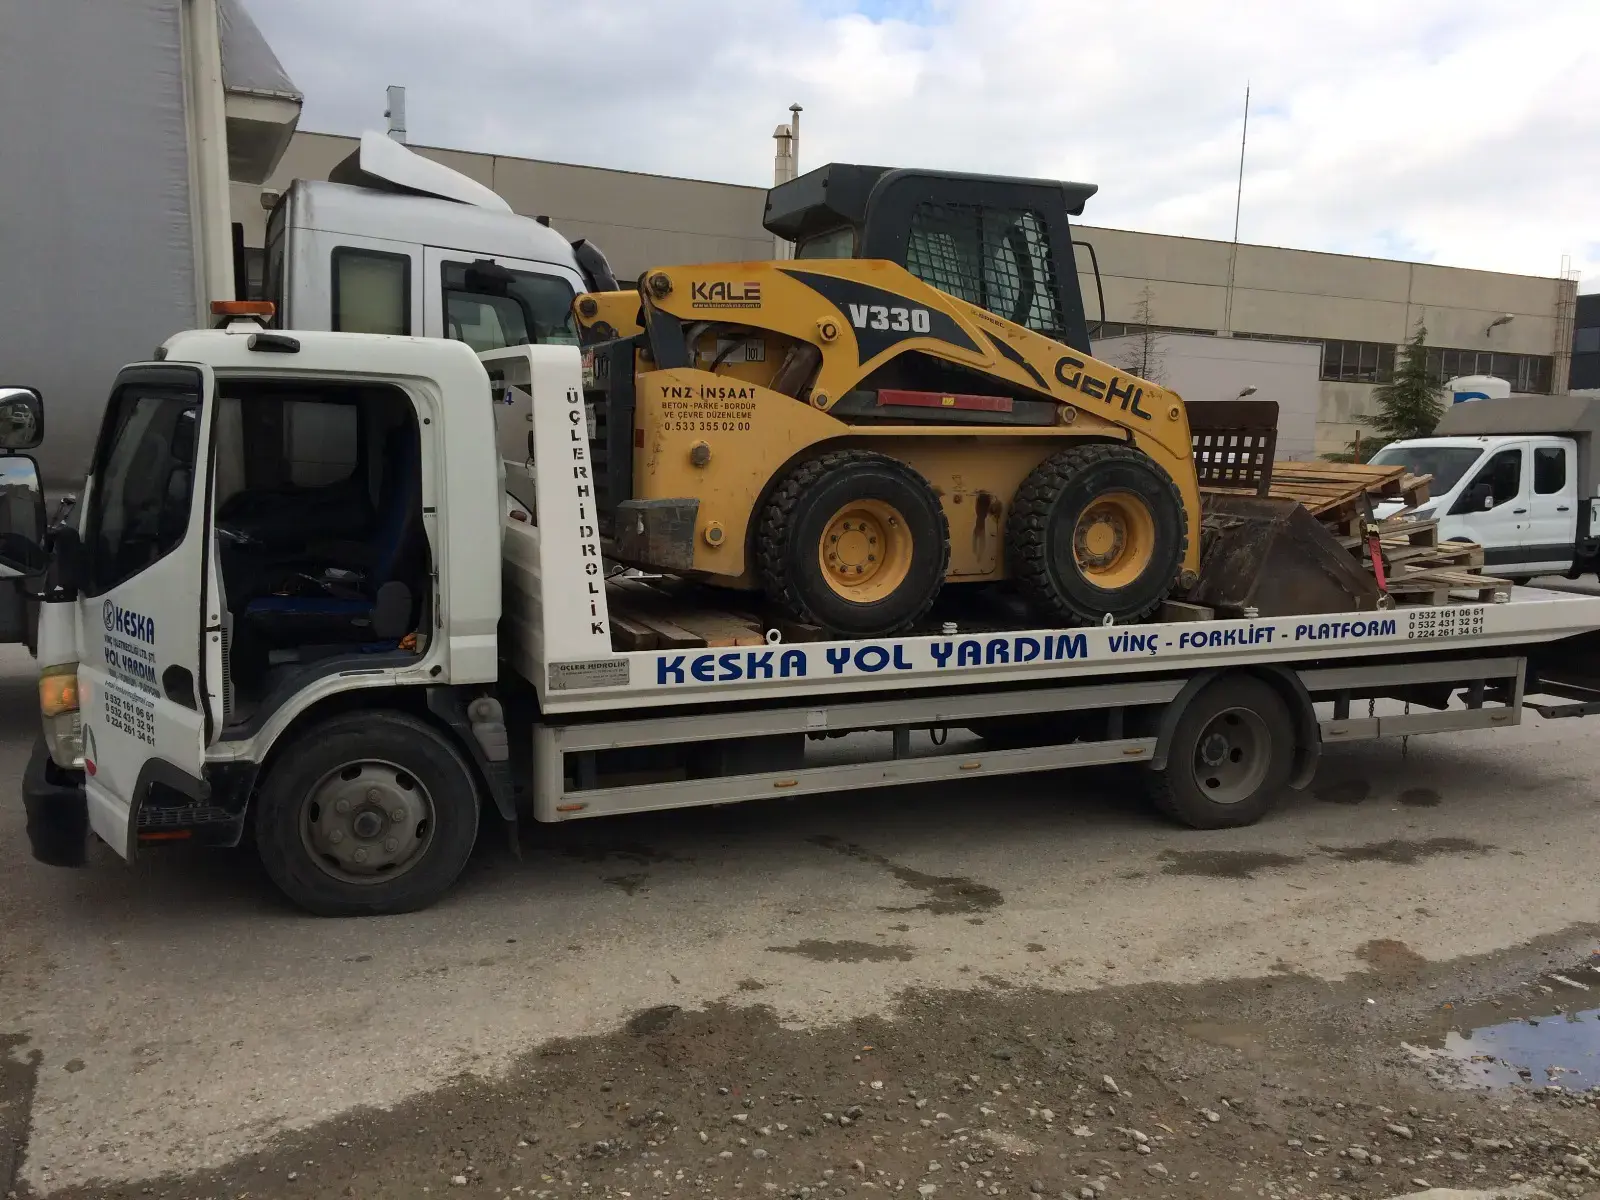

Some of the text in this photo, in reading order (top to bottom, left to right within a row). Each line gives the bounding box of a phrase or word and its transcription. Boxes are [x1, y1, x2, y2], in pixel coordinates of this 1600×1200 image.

[691, 281, 761, 301] KALE
[849, 303, 931, 334] V330
[748, 348, 758, 360] 101
[660, 384, 756, 401] YNZ İNŞAAT
[1054, 356, 1152, 420] GEHL
[677, 411, 704, 420] ÇEVRE
[706, 410, 752, 419] DÜZENLEME
[664, 421, 750, 431] 0.533 355 02 00
[1408, 617, 1484, 629] 0 532 431 32 91
[1409, 607, 1484, 620] 0 532 161 06 61
[116, 606, 155, 646] KESKA
[1408, 631, 1415, 639] 0
[1417, 630, 1435, 638] 224
[1437, 628, 1454, 637] 261
[1458, 627, 1470, 635] 34
[657, 649, 807, 685] KESKA
[826, 644, 913, 674] YOL
[930, 633, 1088, 668] YARDIM
[1108, 630, 1158, 656] VİNÇ
[1179, 623, 1276, 649] FORKLİFT
[1295, 619, 1396, 641] PLATFORM
[104, 646, 121, 669] YOL
[122, 654, 157, 685] YARDIM
[560, 663, 586, 672] ÜÇLER
[105, 691, 154, 723] 0 532 161 06 61
[105, 702, 155, 736] 0 532 431 32 91
[105, 713, 110, 723] 0
[111, 716, 122, 729] 224
[123, 723, 135, 737] 261
[137, 730, 146, 742] 34
